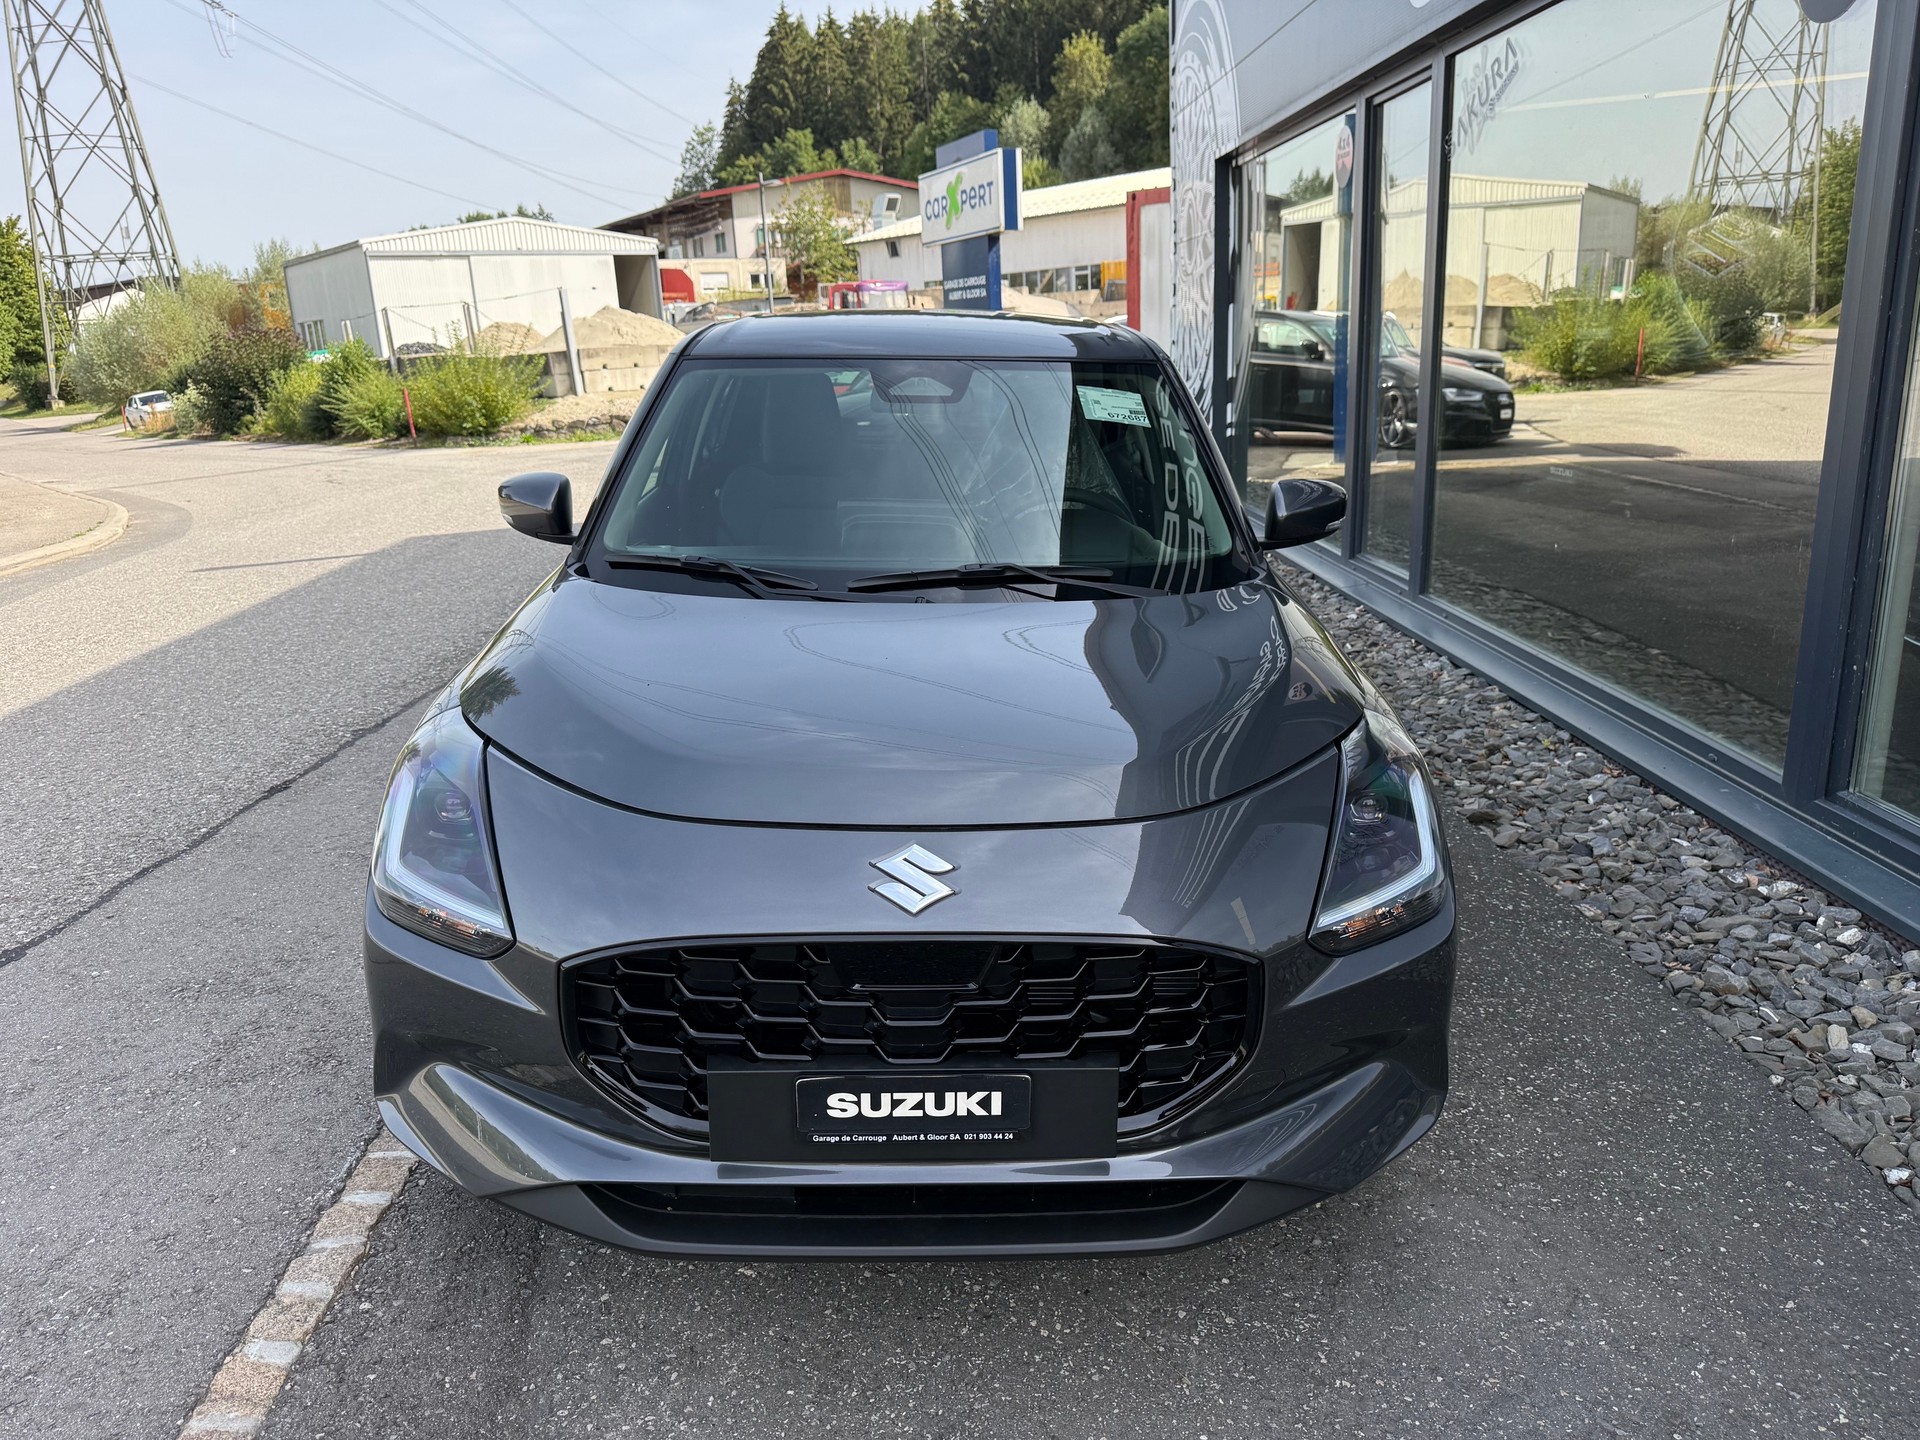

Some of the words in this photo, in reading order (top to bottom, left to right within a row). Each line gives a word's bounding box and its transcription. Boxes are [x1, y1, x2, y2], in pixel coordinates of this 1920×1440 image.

[1107, 412, 1147, 422] 672687
[826, 1091, 1002, 1118] SUZUKI
[812, 1135, 840, 1143] Garage
[852, 1134, 887, 1142] Carrouge
